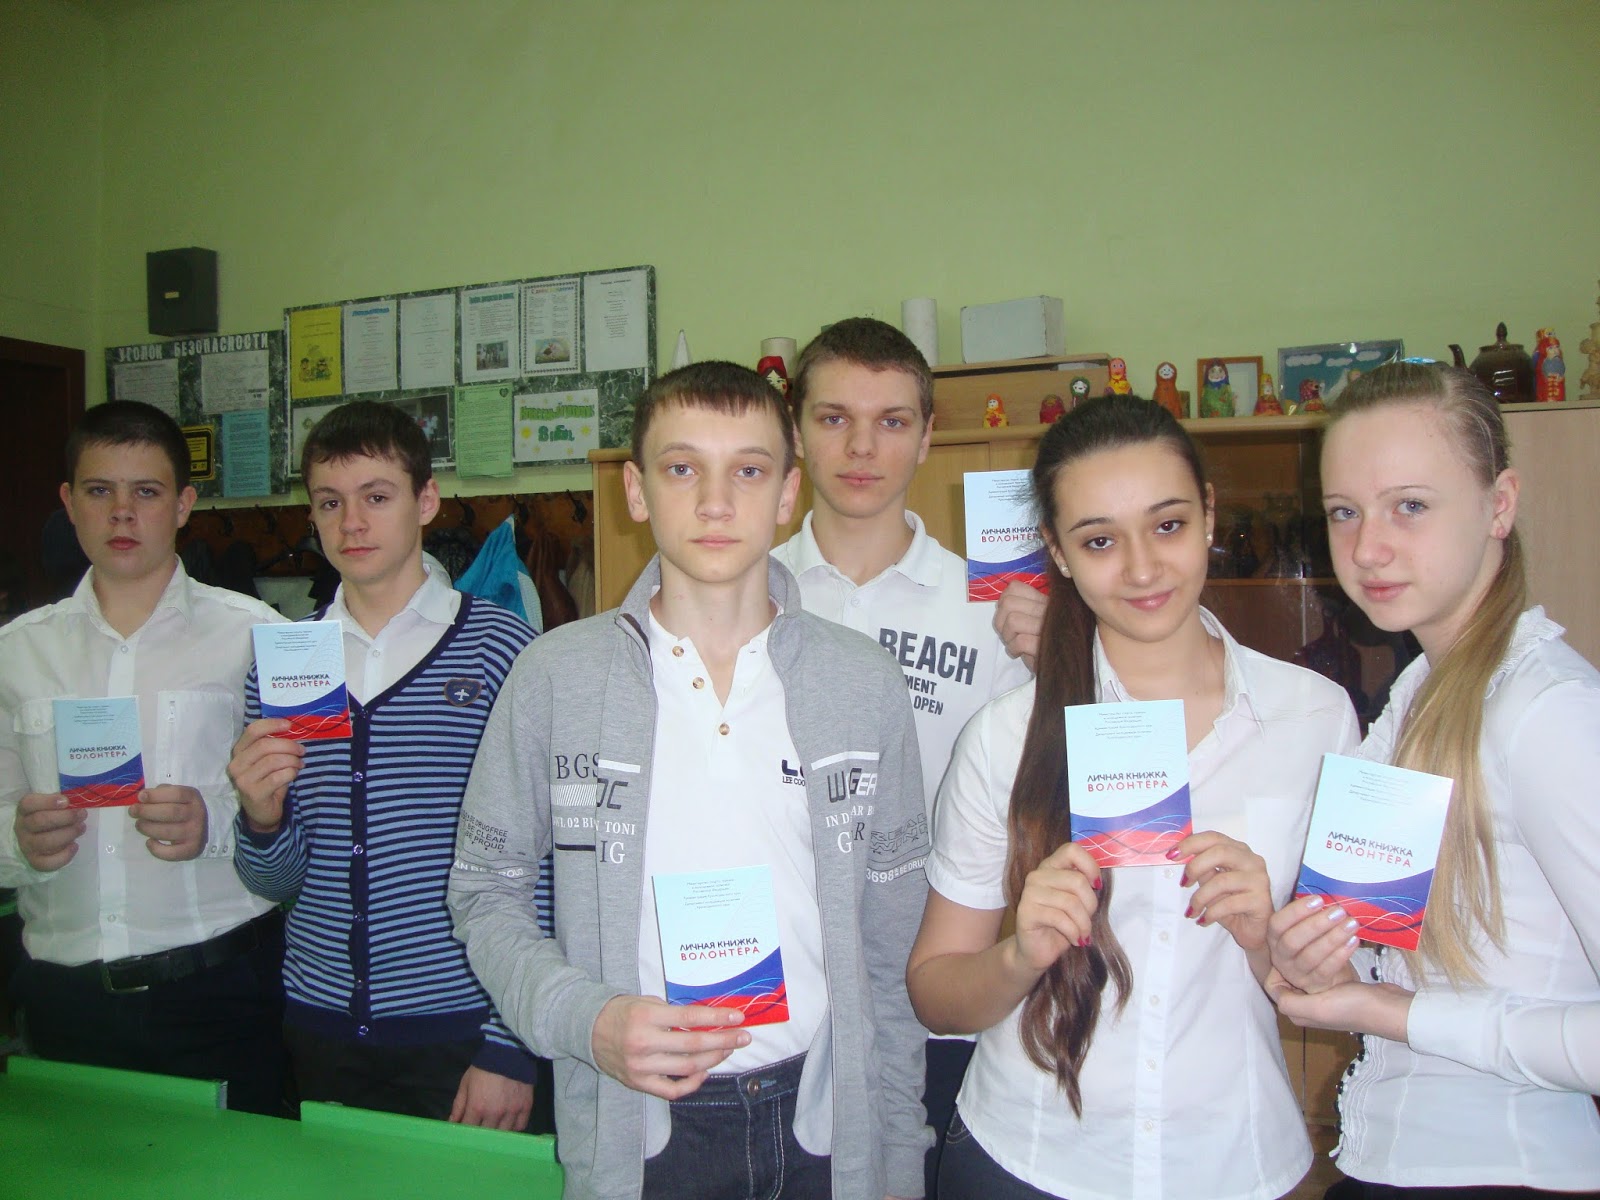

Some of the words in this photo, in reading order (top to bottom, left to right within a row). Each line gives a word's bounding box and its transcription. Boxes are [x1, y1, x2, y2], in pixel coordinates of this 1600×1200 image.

[118, 344, 163, 363] УГОЛОК
[174, 333, 269, 358] БЕЗОПАСНОСТИ
[1012, 526, 1040, 534] КНИЖК
[879, 628, 978, 685] BEACH
[299, 673, 330, 681] КНИЖКА
[913, 695, 944, 716] OPEN
[69, 745, 96, 753] ЛИЧНАЯ
[96, 744, 127, 752] КНИЖКА
[782, 775, 793, 784] LEE
[1087, 772, 1124, 782] ЛИЧНАЯ
[1125, 770, 1168, 780] КНИЖКА
[567, 817, 580, 828] 02
[604, 820, 636, 836] TONI
[473, 835, 505, 850] PROUD
[476, 829, 506, 844] CLEAN
[1327, 831, 1367, 847] ЛИЧНАЯ
[1368, 838, 1413, 857] КНИЖКА
[680, 941, 716, 951] ЛИЧНАЯ
[717, 937, 759, 948] КНИЖКА
